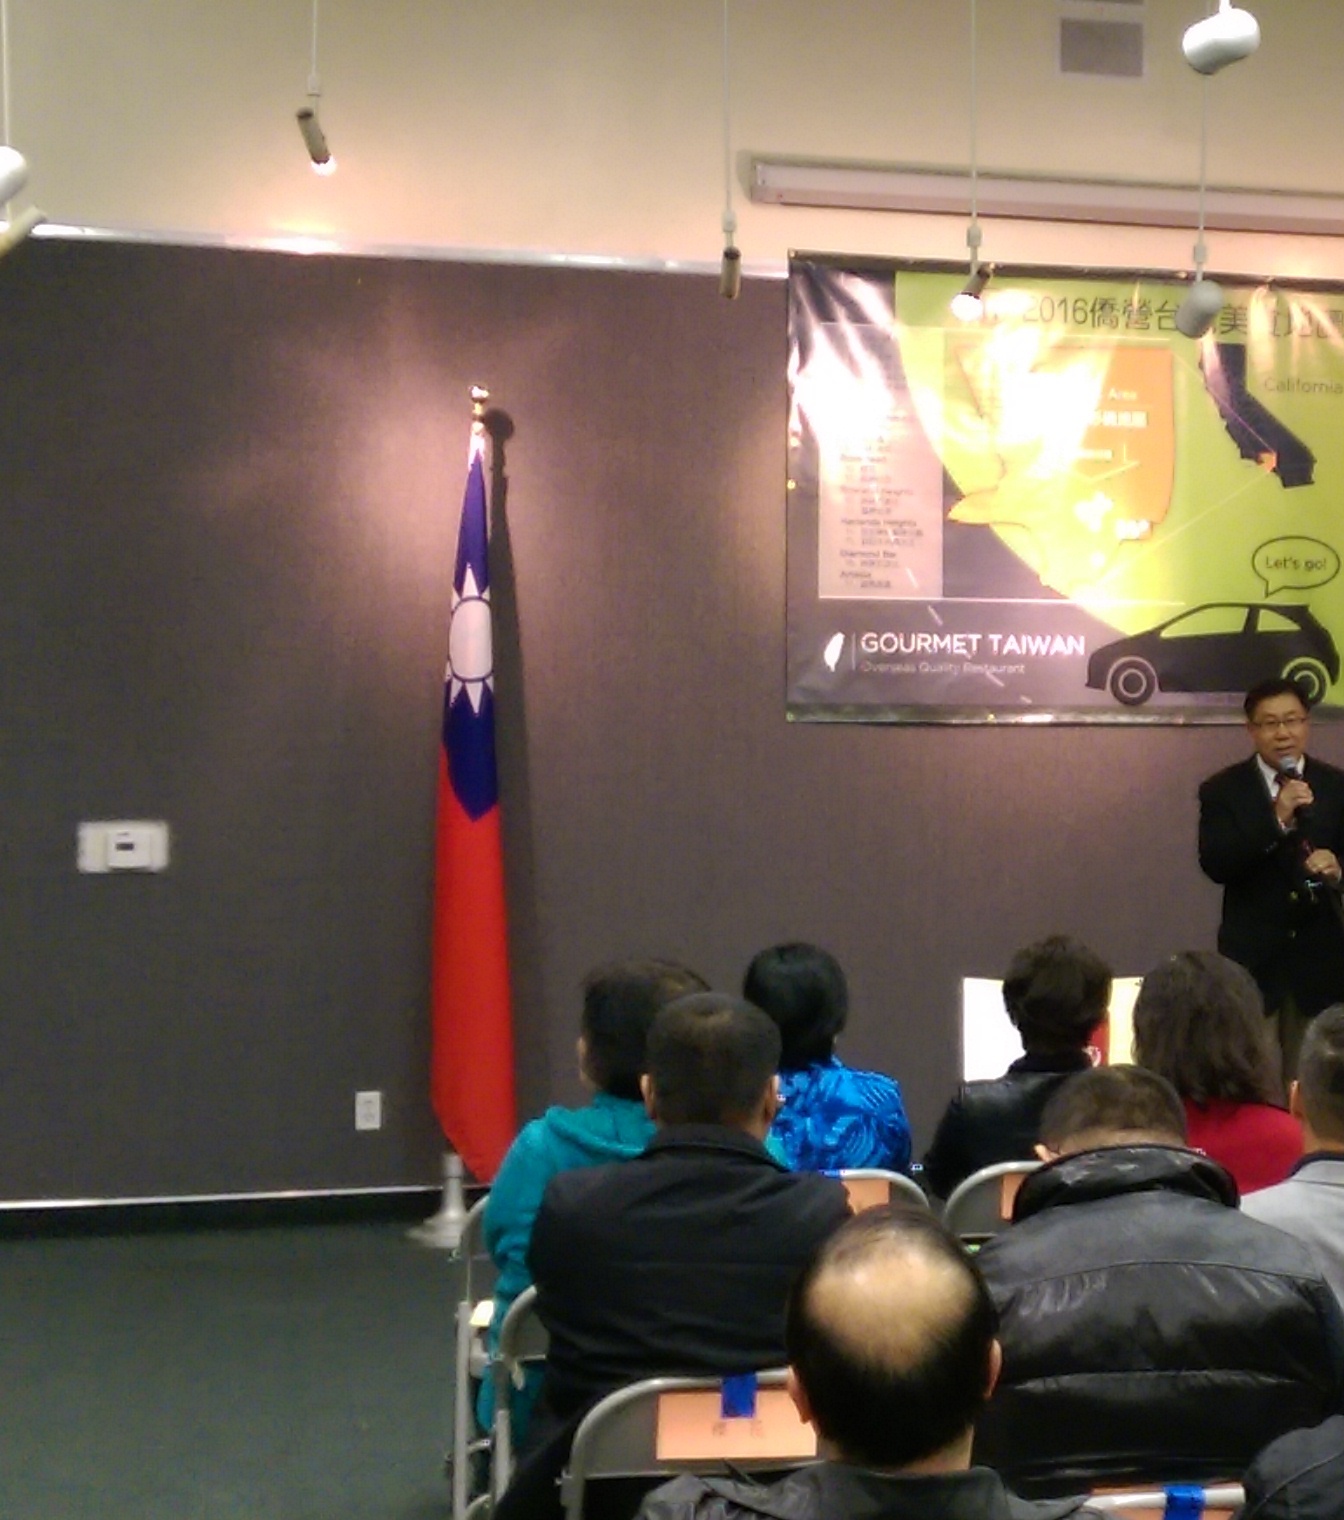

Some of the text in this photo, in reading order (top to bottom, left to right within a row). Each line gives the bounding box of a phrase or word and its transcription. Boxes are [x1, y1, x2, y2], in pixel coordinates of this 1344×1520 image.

[1264, 376, 1344, 394] California
[1265, 556, 1327, 572] Let's go!
[861, 632, 1086, 656] GOURMET TAIWAN
[862, 661, 1026, 676] Overseas Quality Restaurant
